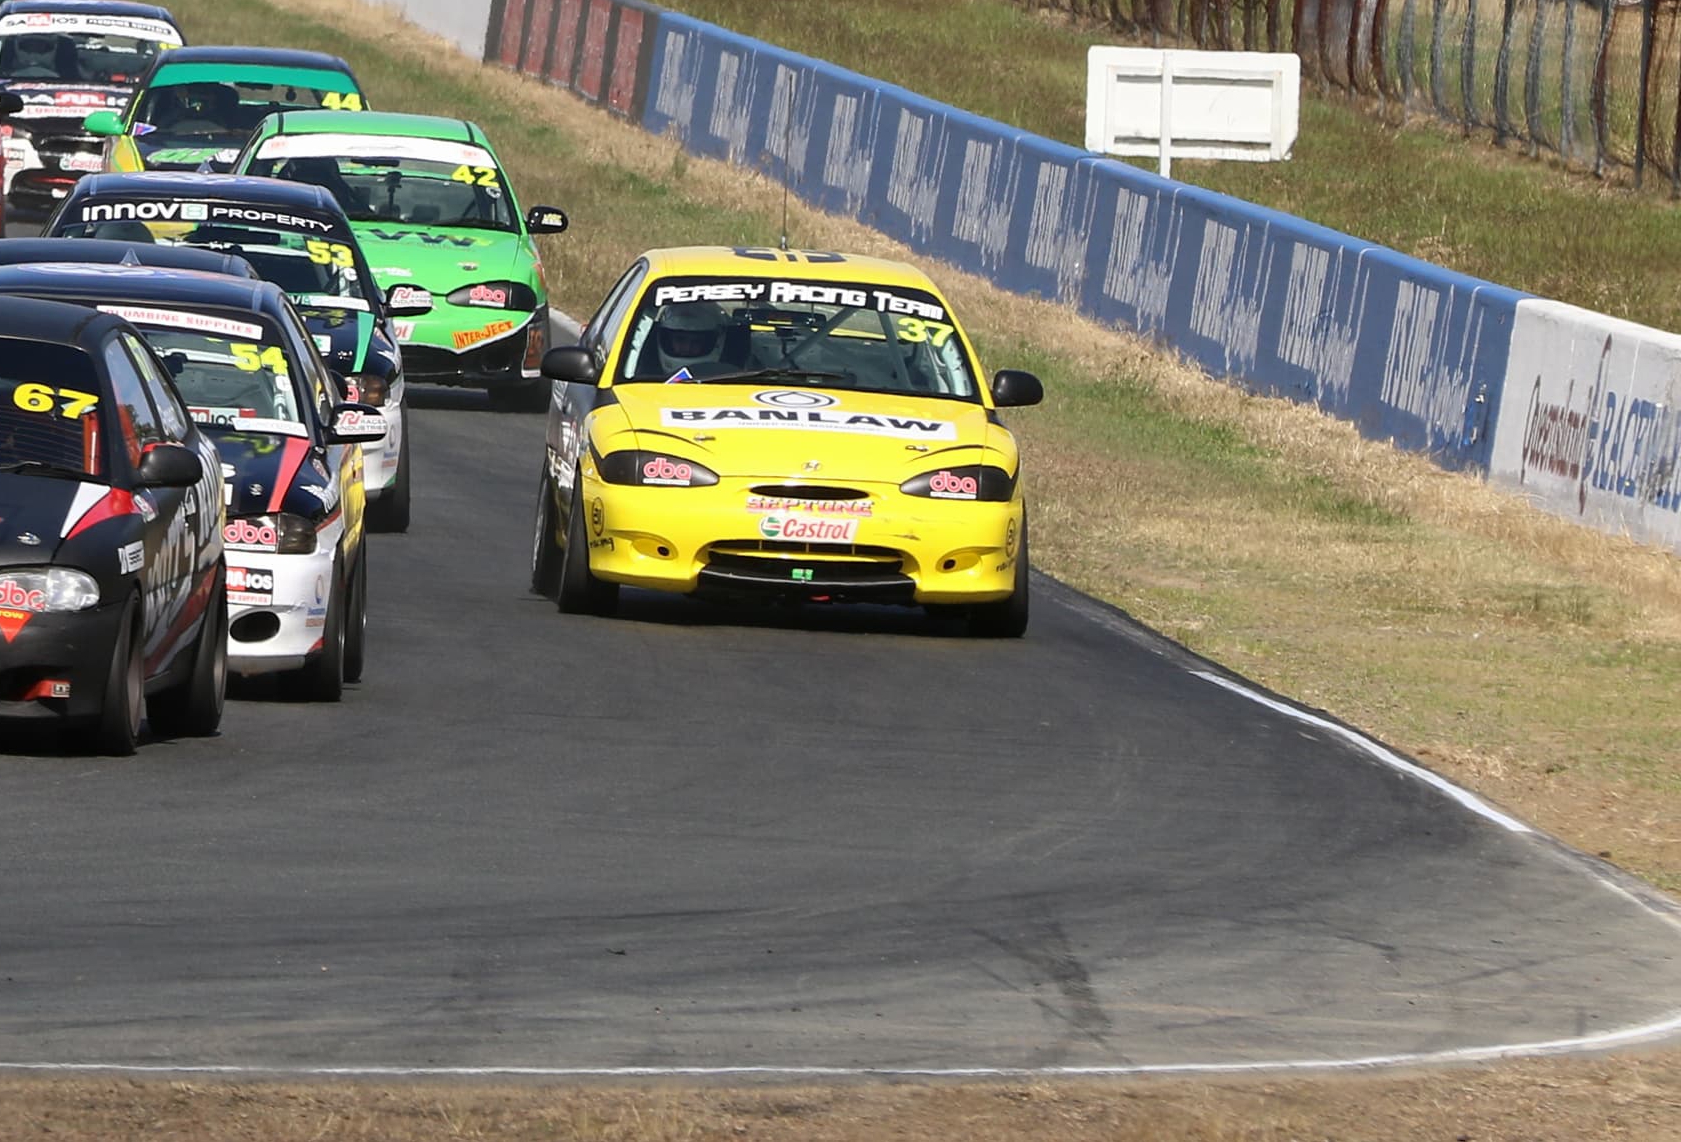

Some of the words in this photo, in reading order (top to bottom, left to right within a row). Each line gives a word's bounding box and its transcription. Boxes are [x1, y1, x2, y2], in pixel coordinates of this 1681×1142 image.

[321, 91, 363, 111] 44
[452, 165, 500, 187] 42
[212, 207, 334, 232] PROPERTY
[306, 240, 355, 267] 53
[469, 285, 506, 302] dba
[186, 316, 254, 334] SUPPLIES
[898, 318, 954, 347] 37
[230, 343, 288, 374] 54
[12, 383, 99, 420] 67
[670, 409, 942, 432] BANLAW
[643, 457, 692, 480] dba
[929, 470, 977, 493] dba
[224, 519, 277, 545] dba
[783, 518, 851, 540] Castrol
